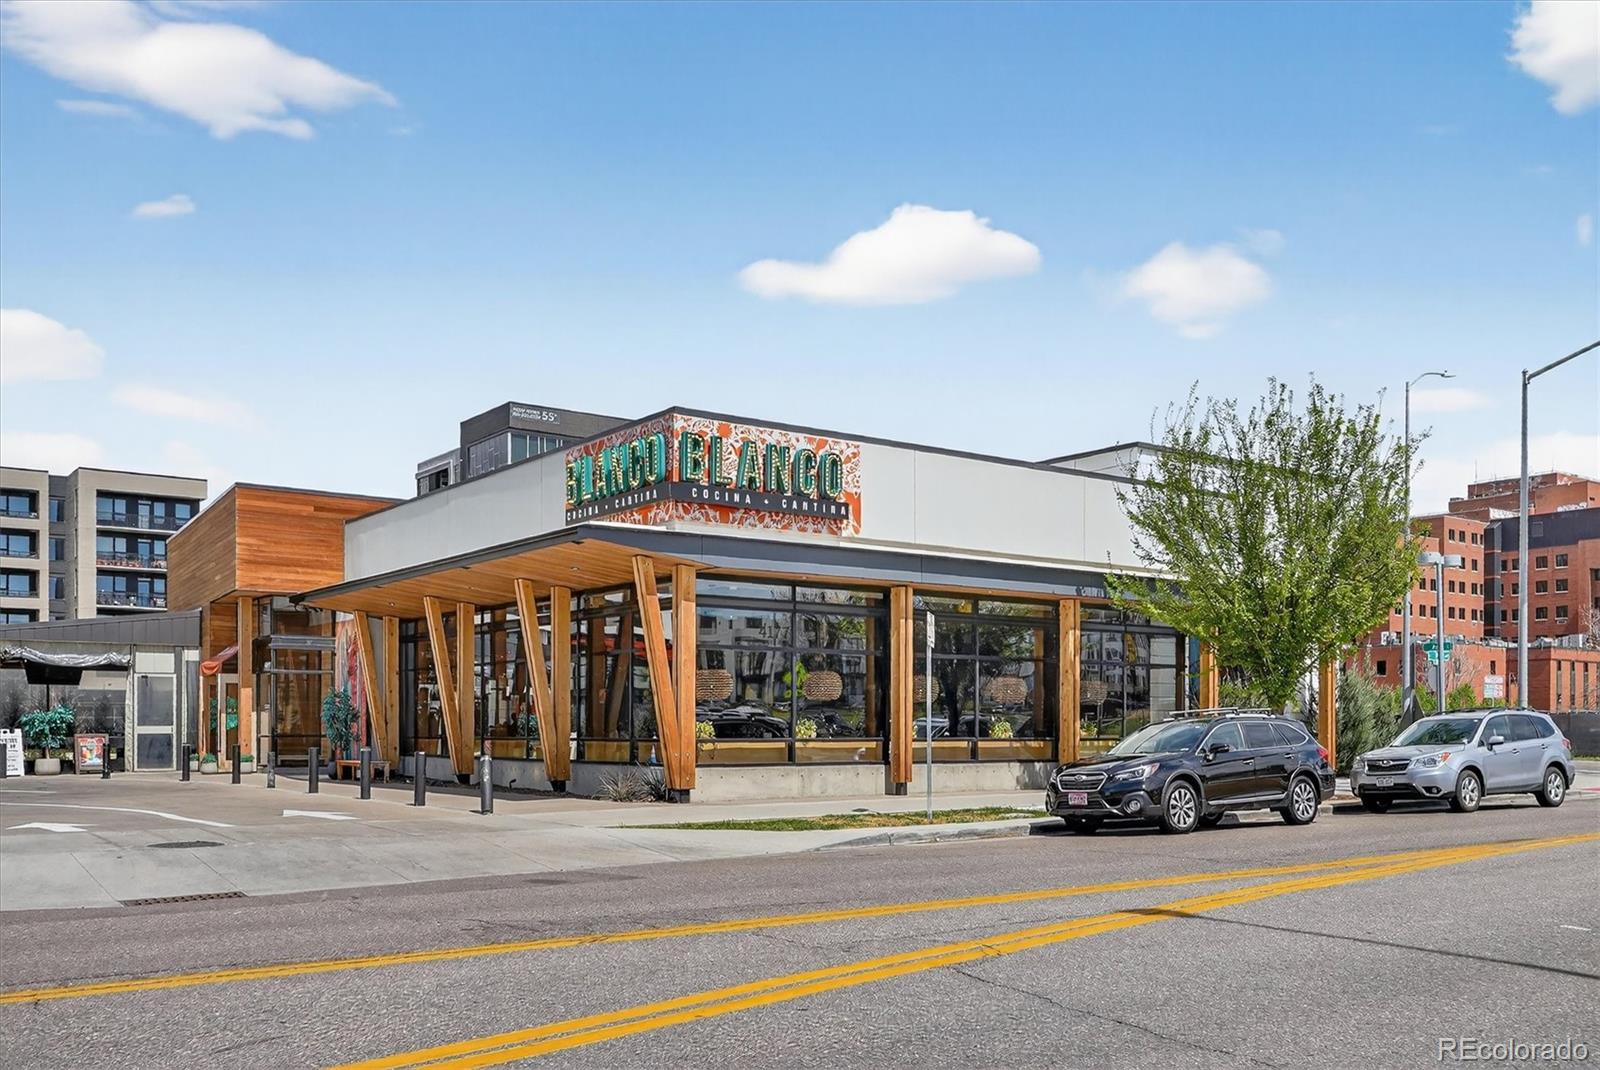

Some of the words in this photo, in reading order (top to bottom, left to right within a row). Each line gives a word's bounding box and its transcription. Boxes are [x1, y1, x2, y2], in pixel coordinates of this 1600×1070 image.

[566, 432, 665, 506] BLANCO
[678, 430, 843, 501] BLANCO
[614, 489, 658, 509] CANTINA
[691, 487, 751, 505] COCINA
[781, 500, 847, 516] CANTINA
